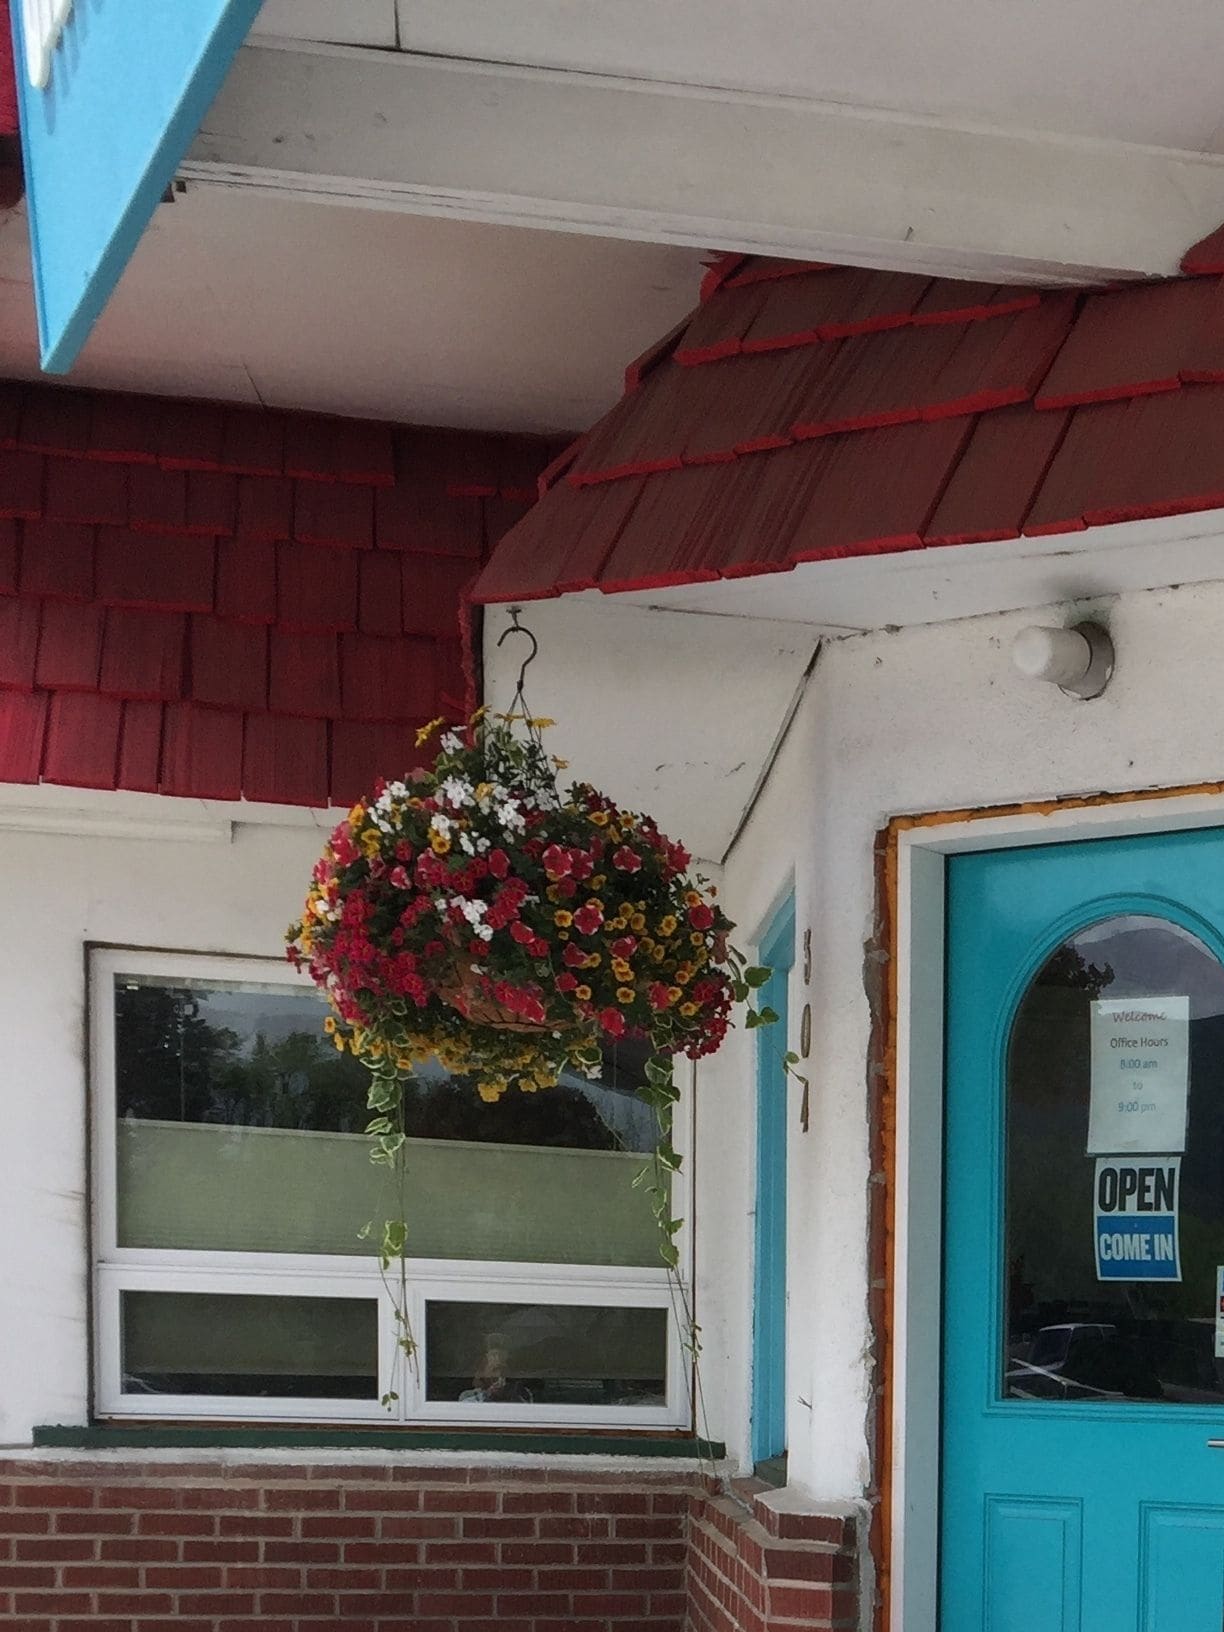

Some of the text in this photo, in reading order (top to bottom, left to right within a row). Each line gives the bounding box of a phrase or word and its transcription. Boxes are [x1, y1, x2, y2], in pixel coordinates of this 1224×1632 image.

[1112, 1011, 1167, 1023] Welcome
[1110, 1036, 1169, 1048] Office Hours
[1143, 1060, 1158, 1069] am
[1133, 1081, 1143, 1091] to
[1118, 1101, 1156, 1114] 9:00 pm
[1098, 1167, 1176, 1212] OPEN
[1100, 1233, 1174, 1261] COME IN
